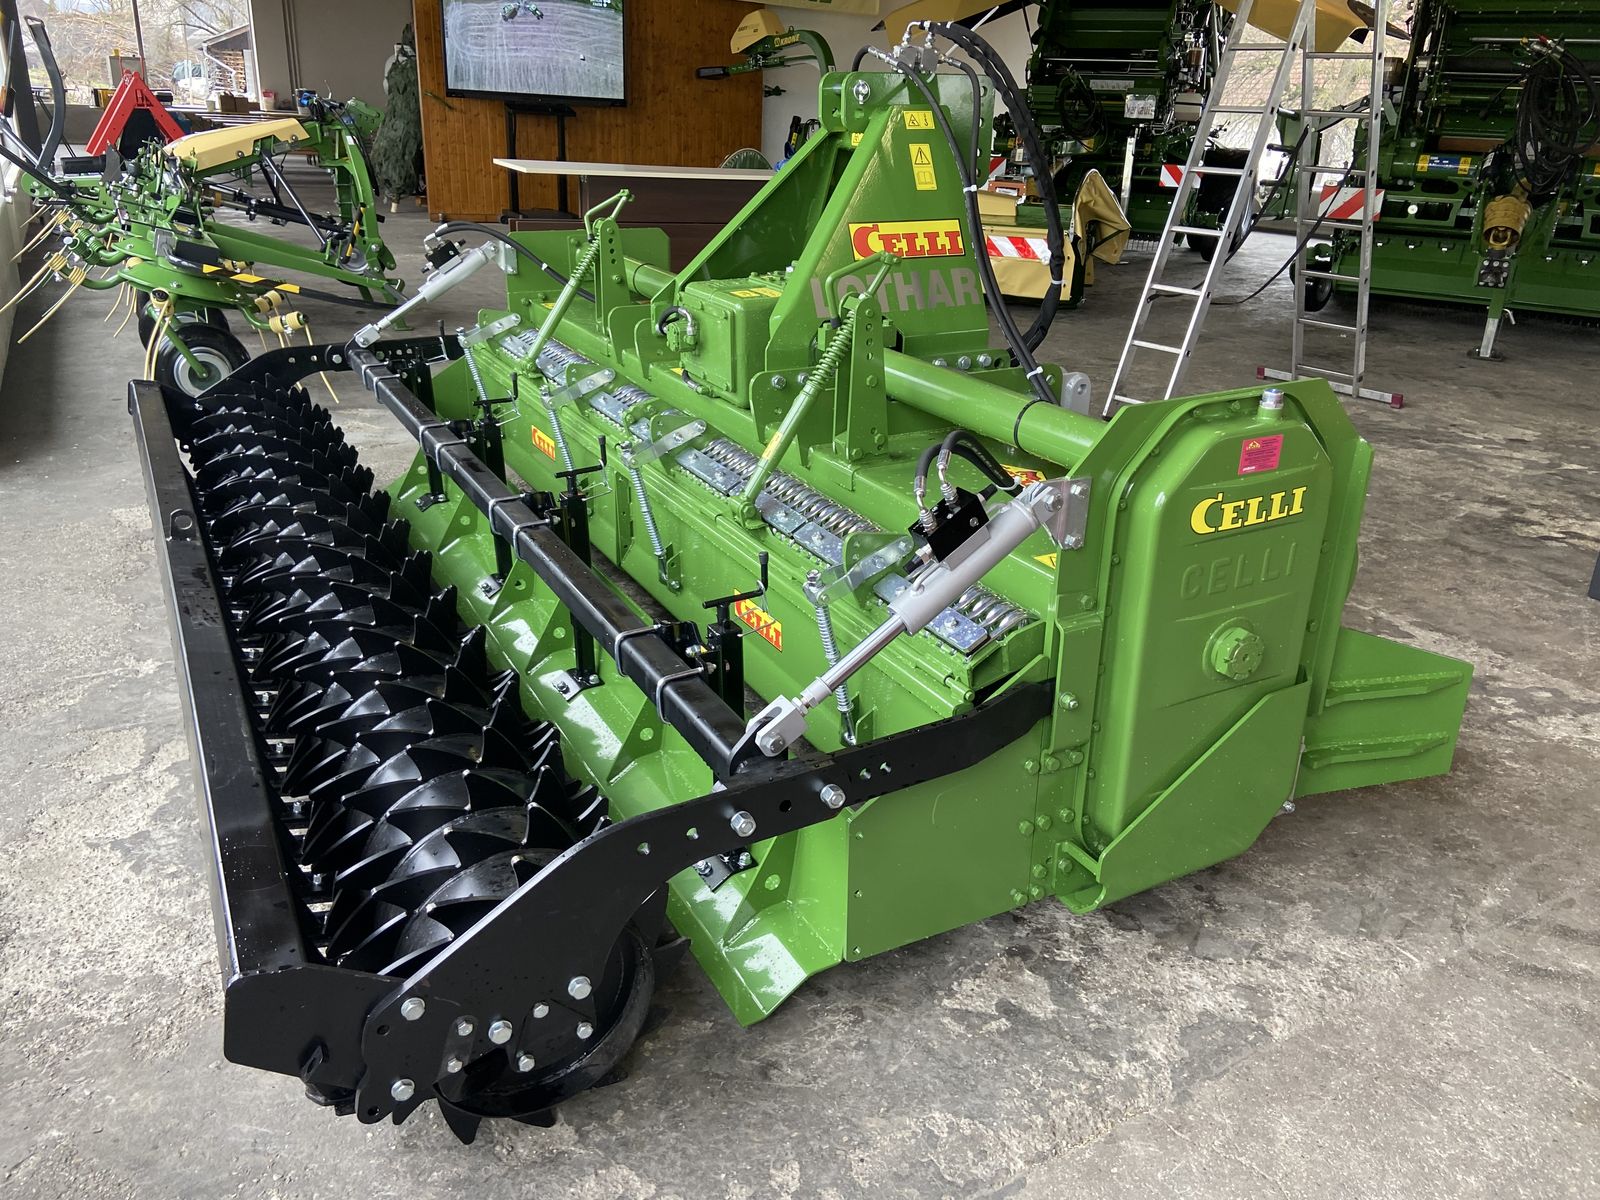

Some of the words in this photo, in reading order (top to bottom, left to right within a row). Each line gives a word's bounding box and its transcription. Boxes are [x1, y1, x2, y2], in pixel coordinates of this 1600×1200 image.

[853, 224, 963, 258] CELLI
[532, 428, 555, 460] CELLI
[1190, 486, 1307, 535] CELLI
[1180, 542, 1297, 600] CELLI
[735, 596, 782, 650] CELLI
